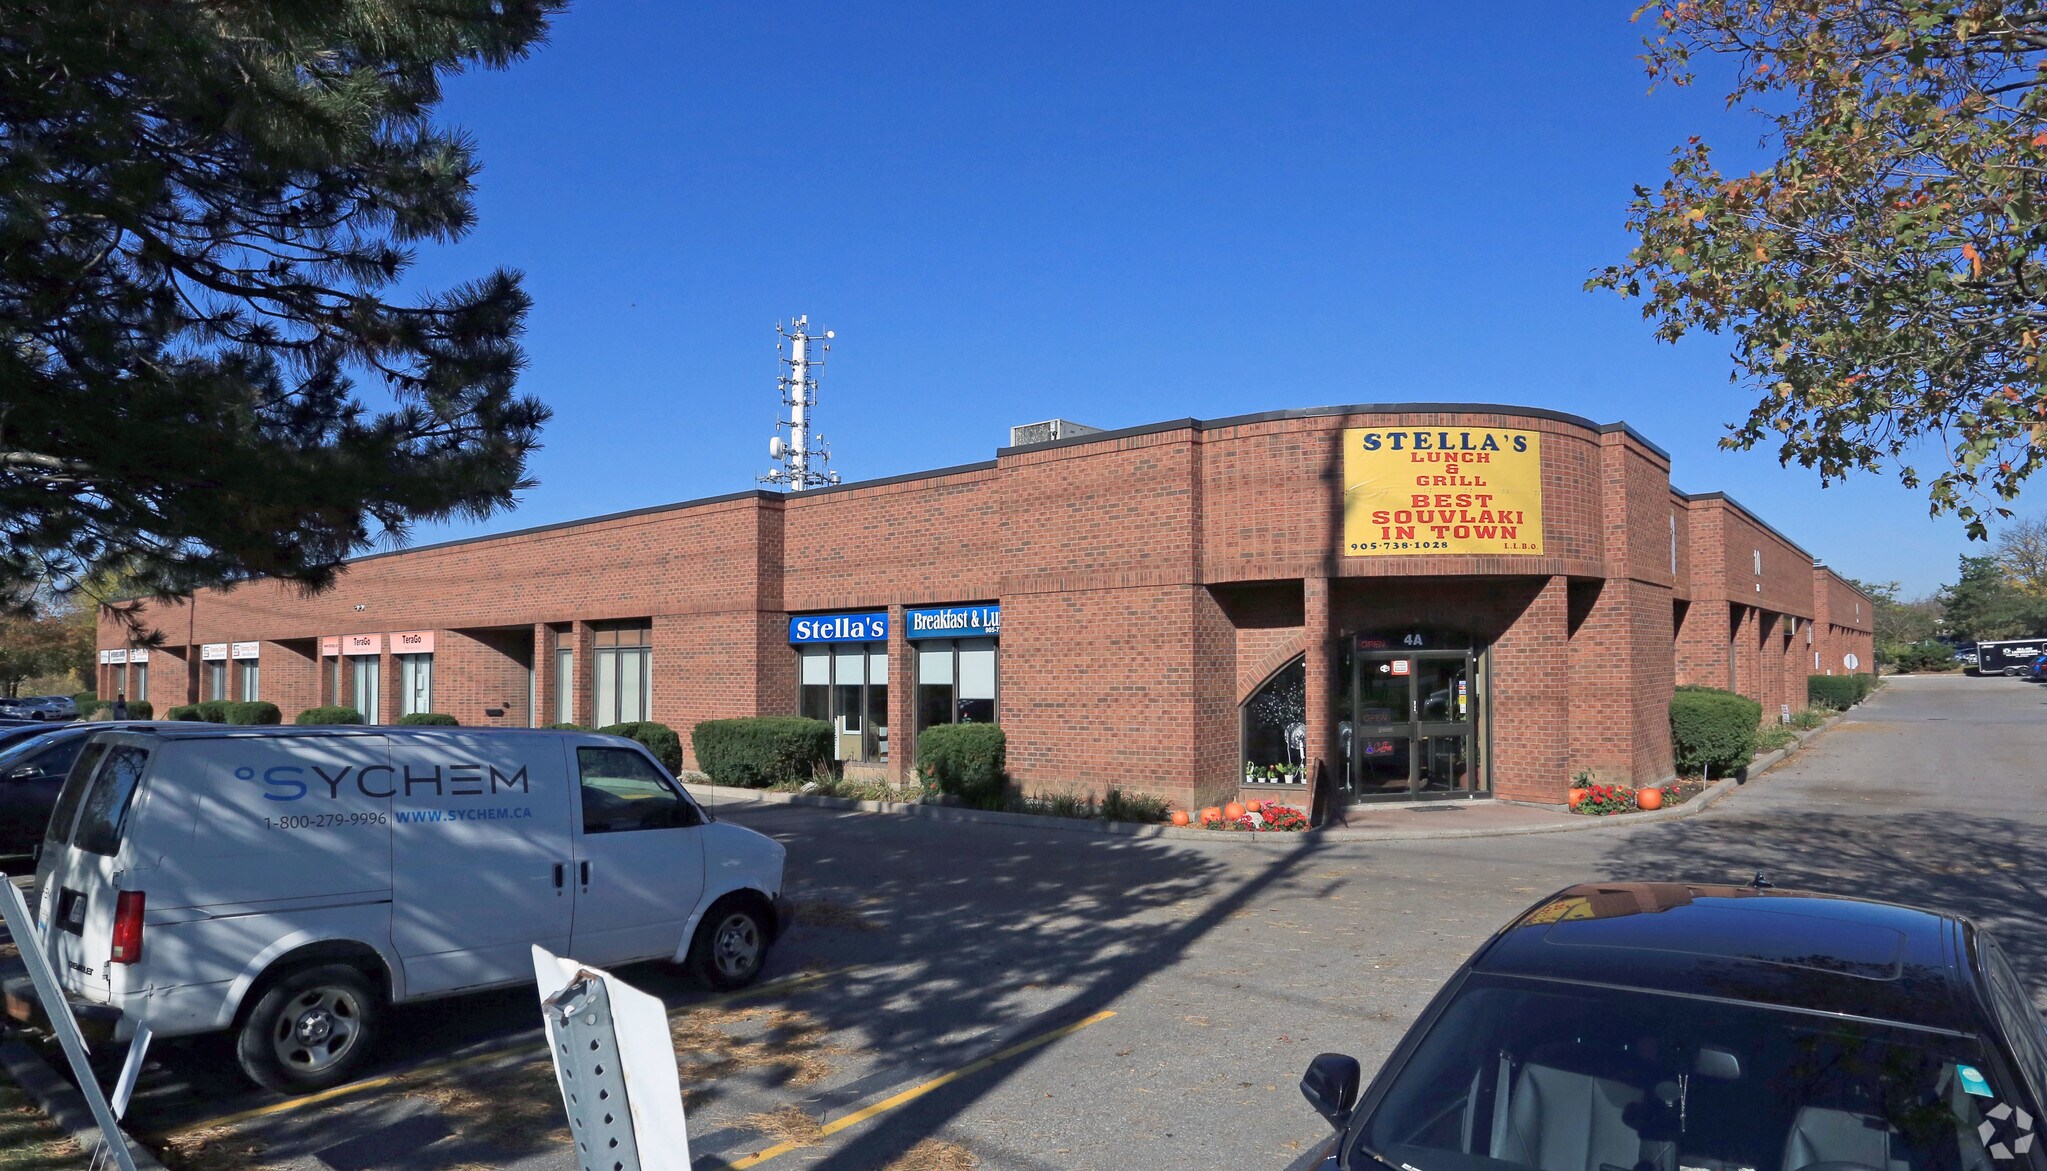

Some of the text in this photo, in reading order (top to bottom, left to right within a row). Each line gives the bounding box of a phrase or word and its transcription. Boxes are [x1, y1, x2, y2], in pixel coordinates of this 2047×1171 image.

[1363, 432, 1527, 453] STELLA'S
[1411, 452, 1490, 463] LUNCH
[1445, 464, 1459, 475] &
[1416, 475, 1487, 486] GRILL
[1411, 494, 1493, 508] BEST
[1372, 510, 1524, 525] SOUVLAKI
[1381, 525, 1517, 540] IN TOWN
[913, 608, 1000, 631] Breakfast & Lu
[796, 617, 884, 640] Stella's
[353, 637, 371, 646] TeraGo
[402, 634, 421, 644] TeraGo
[1403, 633, 1423, 646] 4A
[264, 807, 532, 830] 1-800-279-9996 WWW.SYCHEM.CA
